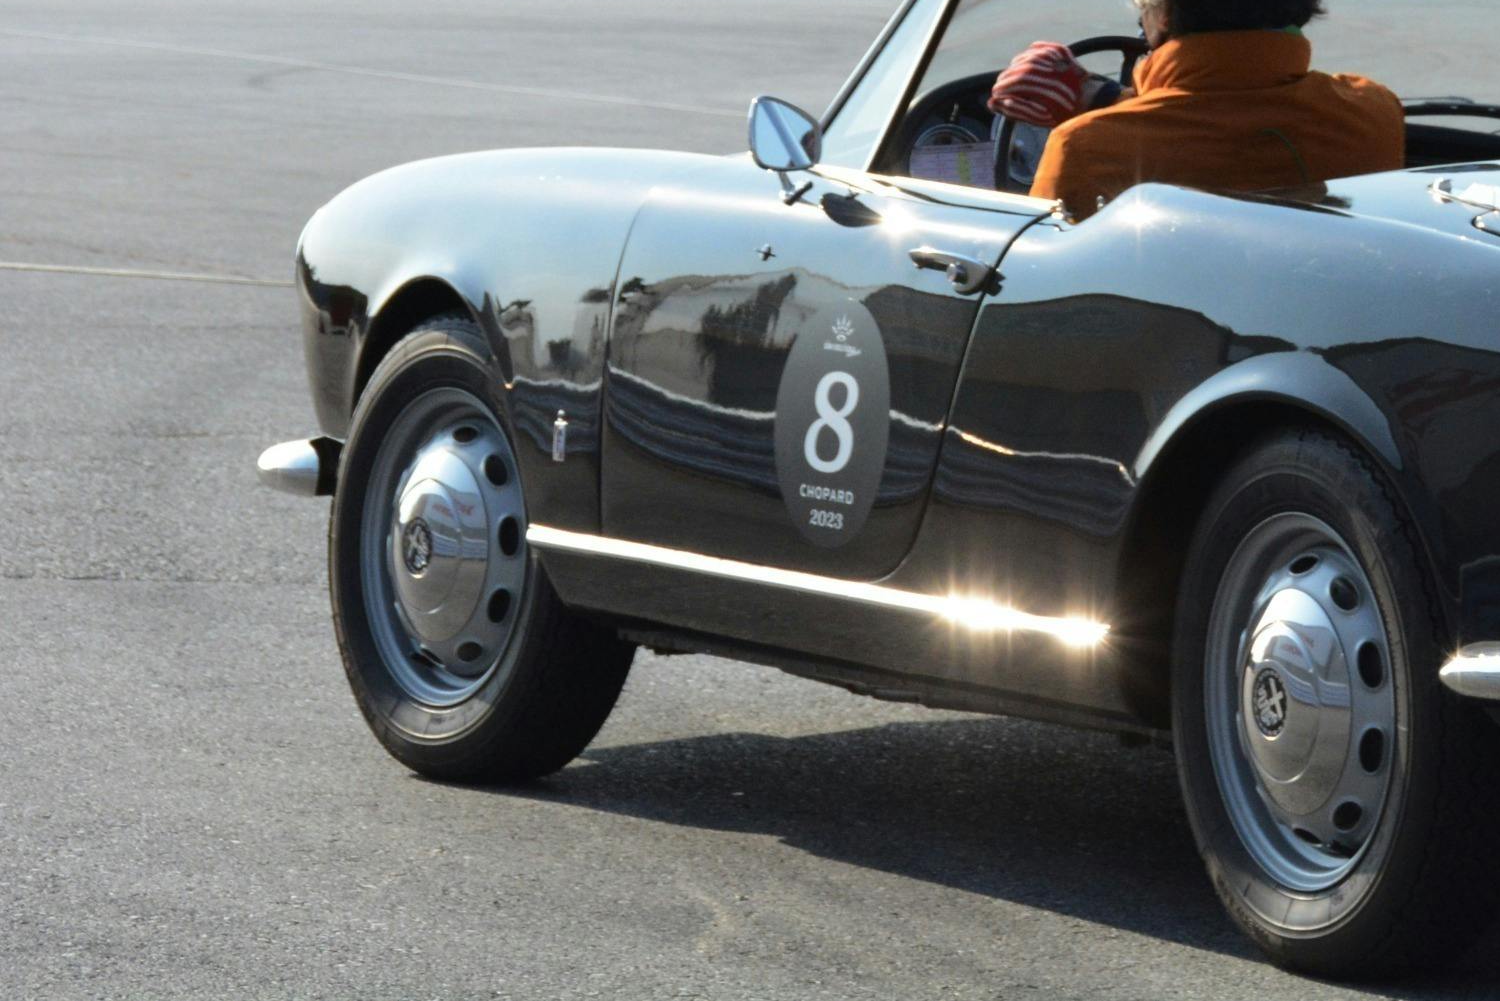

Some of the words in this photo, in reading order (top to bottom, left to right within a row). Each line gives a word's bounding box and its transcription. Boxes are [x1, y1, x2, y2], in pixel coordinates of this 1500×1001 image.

[804, 371, 859, 473] 8
[799, 484, 854, 504] CHOPARD
[809, 508, 844, 530] 2023
